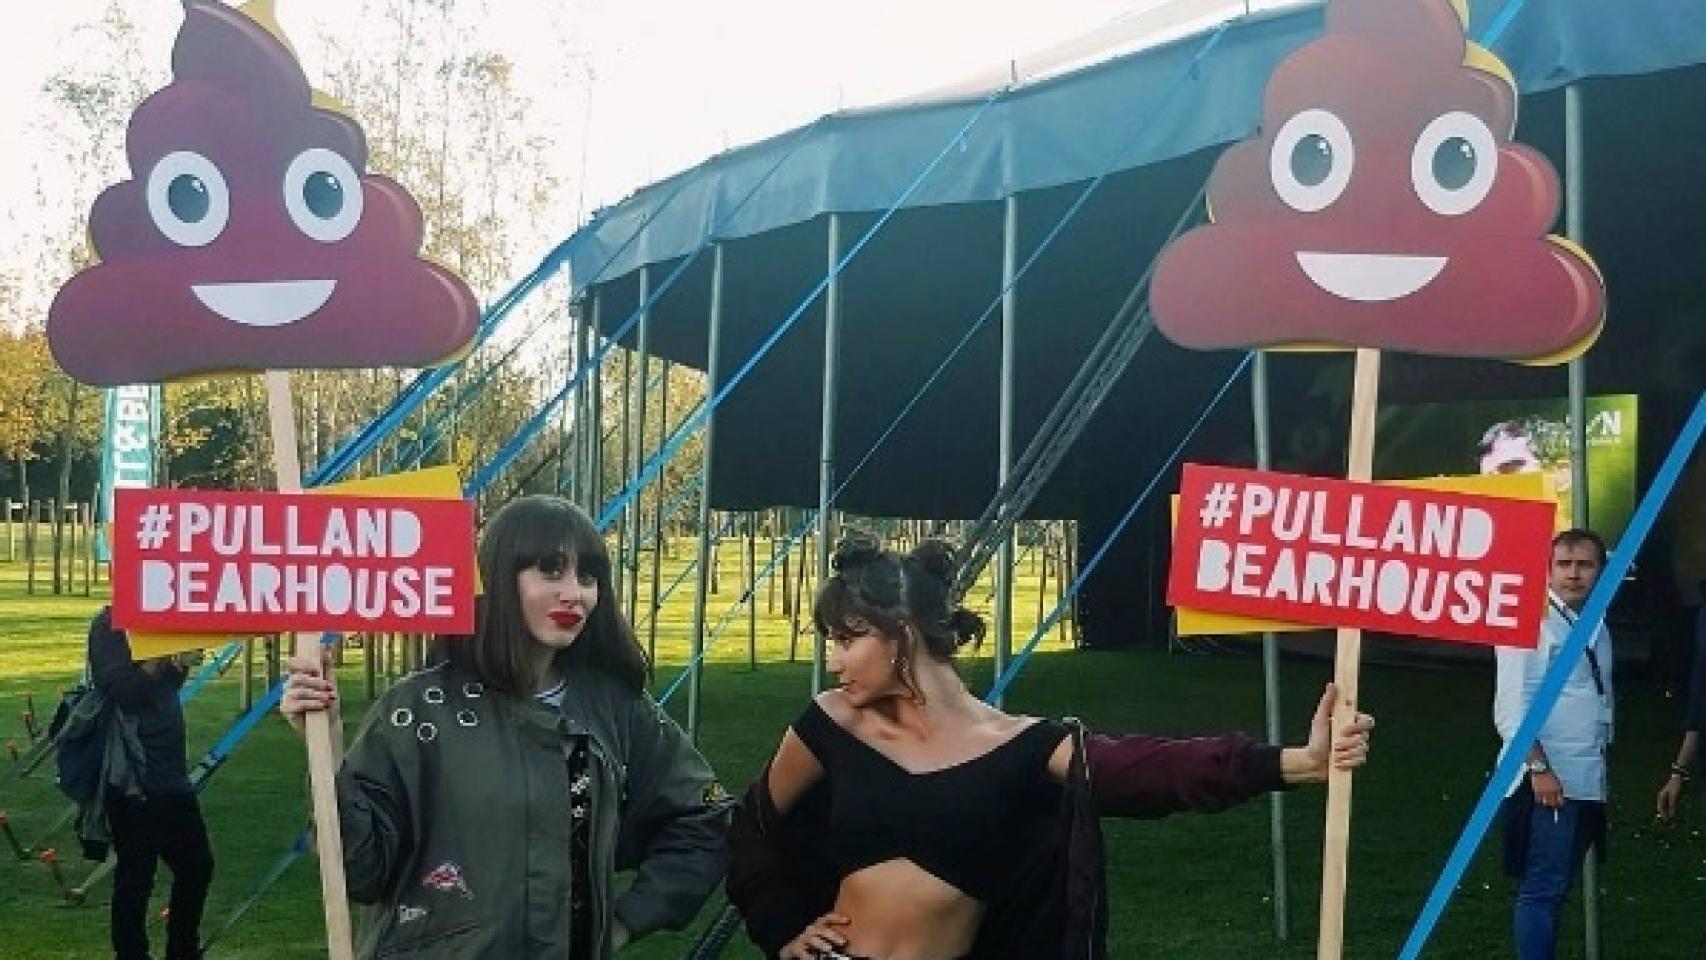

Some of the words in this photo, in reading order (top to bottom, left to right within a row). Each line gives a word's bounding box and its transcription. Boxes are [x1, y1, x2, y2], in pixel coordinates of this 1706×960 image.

[136, 503, 423, 558] #PULLAND
[1200, 482, 1494, 560] #PULLAND
[142, 560, 454, 619] BEARHOUSE
[1196, 540, 1524, 628] BEARHOUSE
